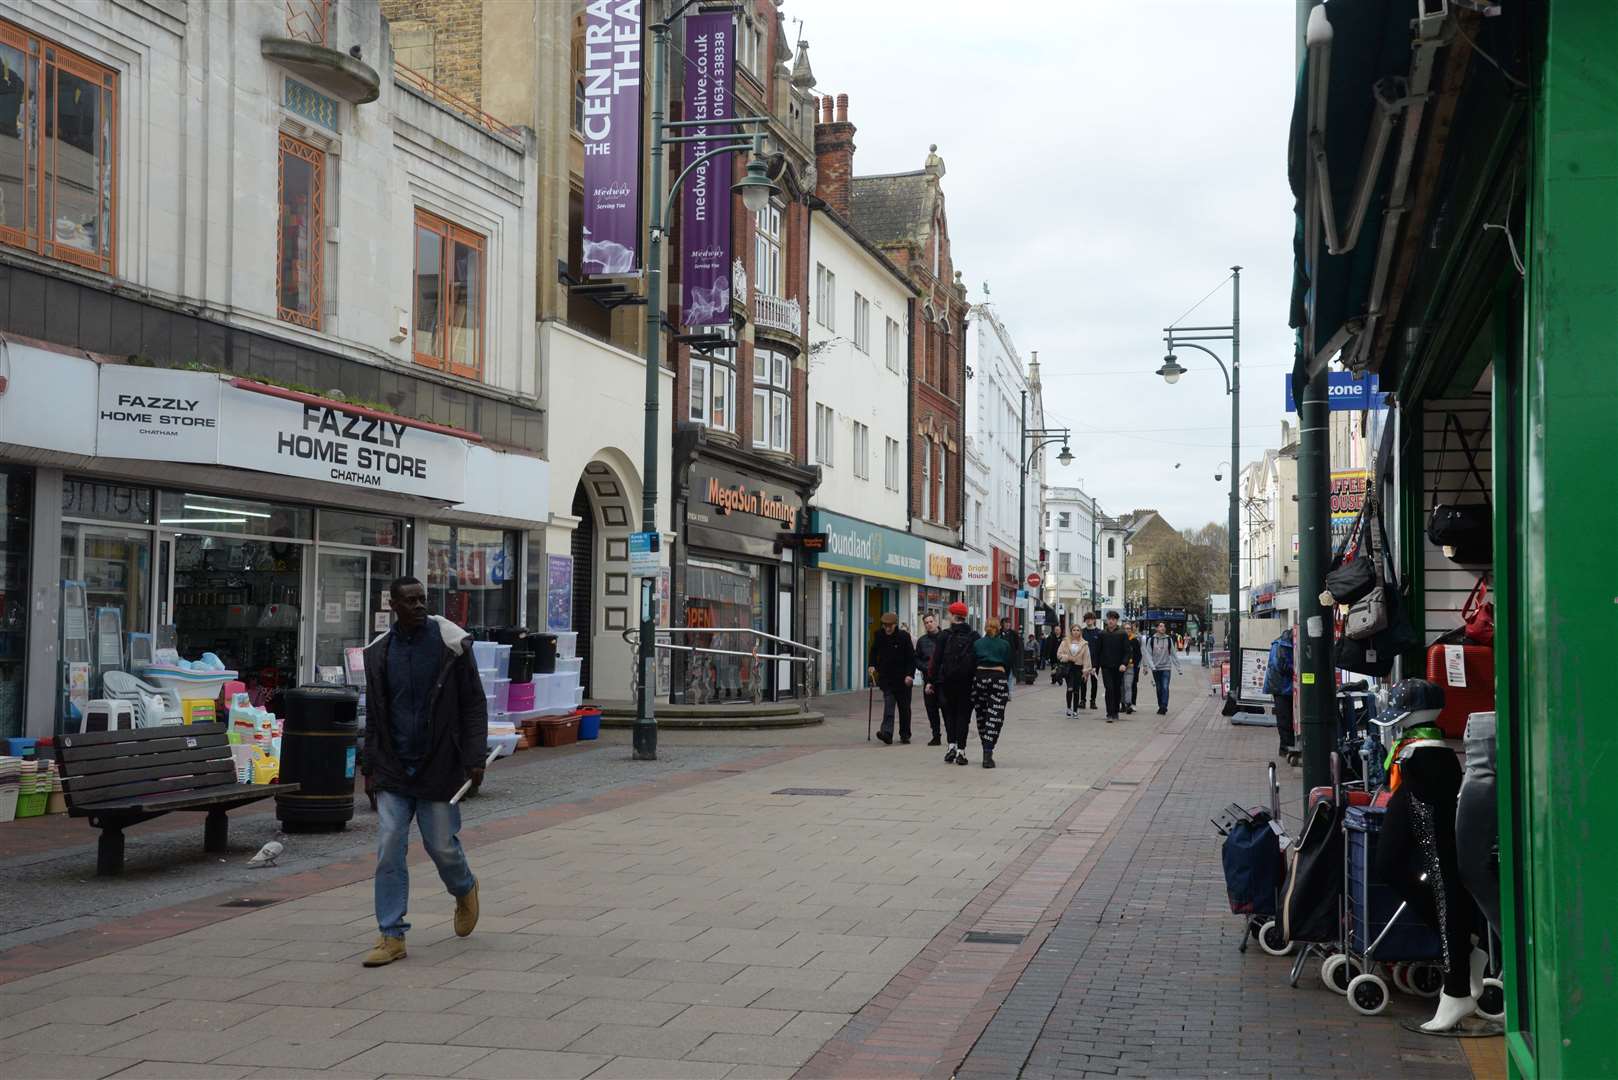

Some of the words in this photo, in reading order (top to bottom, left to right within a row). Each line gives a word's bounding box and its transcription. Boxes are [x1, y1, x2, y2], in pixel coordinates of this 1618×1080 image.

[714, 31, 725, 76] 338338
[714, 79, 725, 117] 01634
[584, 143, 611, 155] THE
[593, 187, 630, 197] Medway
[118, 394, 200, 412] FAZZLY
[100, 410, 153, 424] HOME
[159, 415, 216, 428] STORE
[303, 403, 408, 449] FAZZLY
[139, 428, 179, 437] CHATHAM
[277, 431, 349, 465] HOME
[357, 446, 427, 480] STORE
[330, 468, 382, 487] CHATHAM
[708, 477, 757, 518] MegaSun
[759, 491, 797, 530] Tanning
[1331, 494, 1362, 511] OUSE
[825, 523, 872, 560] Poundland
[967, 572, 989, 580] House
